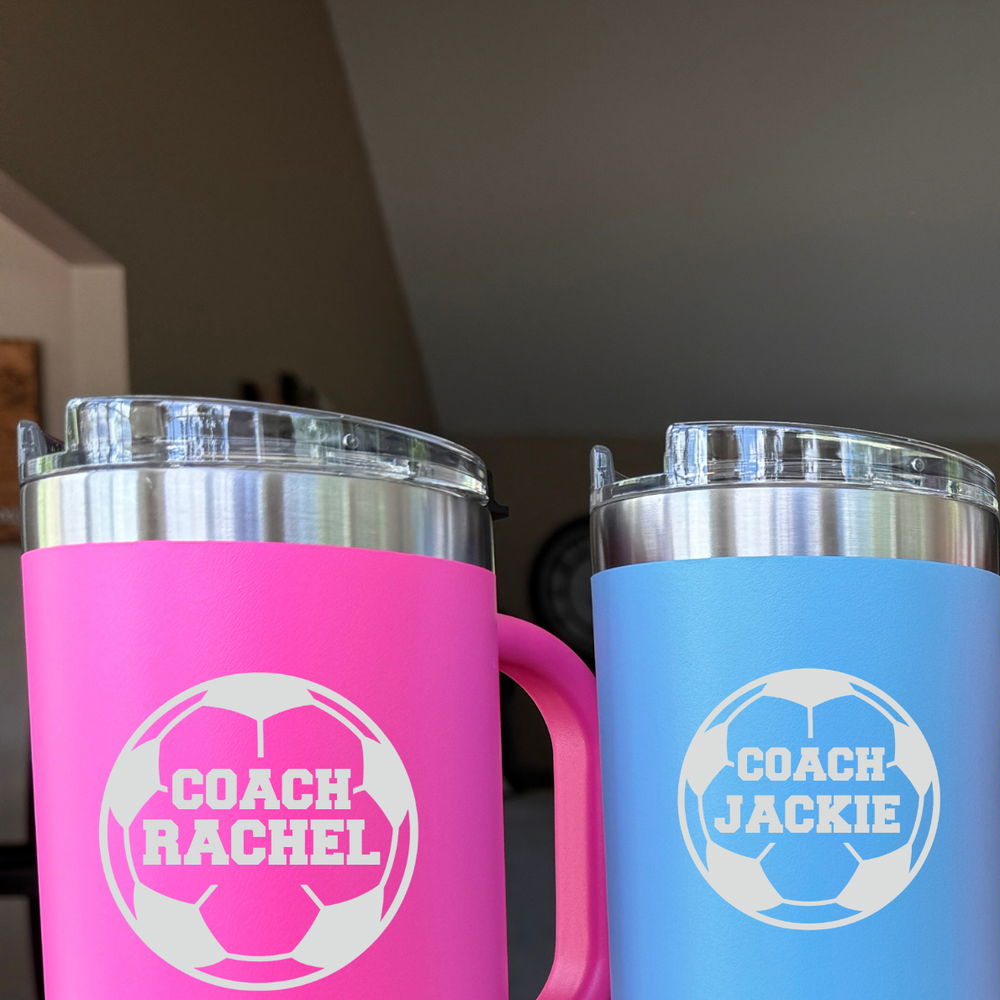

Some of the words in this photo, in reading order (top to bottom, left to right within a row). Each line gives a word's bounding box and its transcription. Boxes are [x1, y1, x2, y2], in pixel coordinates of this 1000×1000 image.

[738, 747, 885, 782] COACH
[171, 768, 351, 810] COACH
[714, 794, 901, 836] JACKIE
[142, 819, 381, 866] RACHEL
